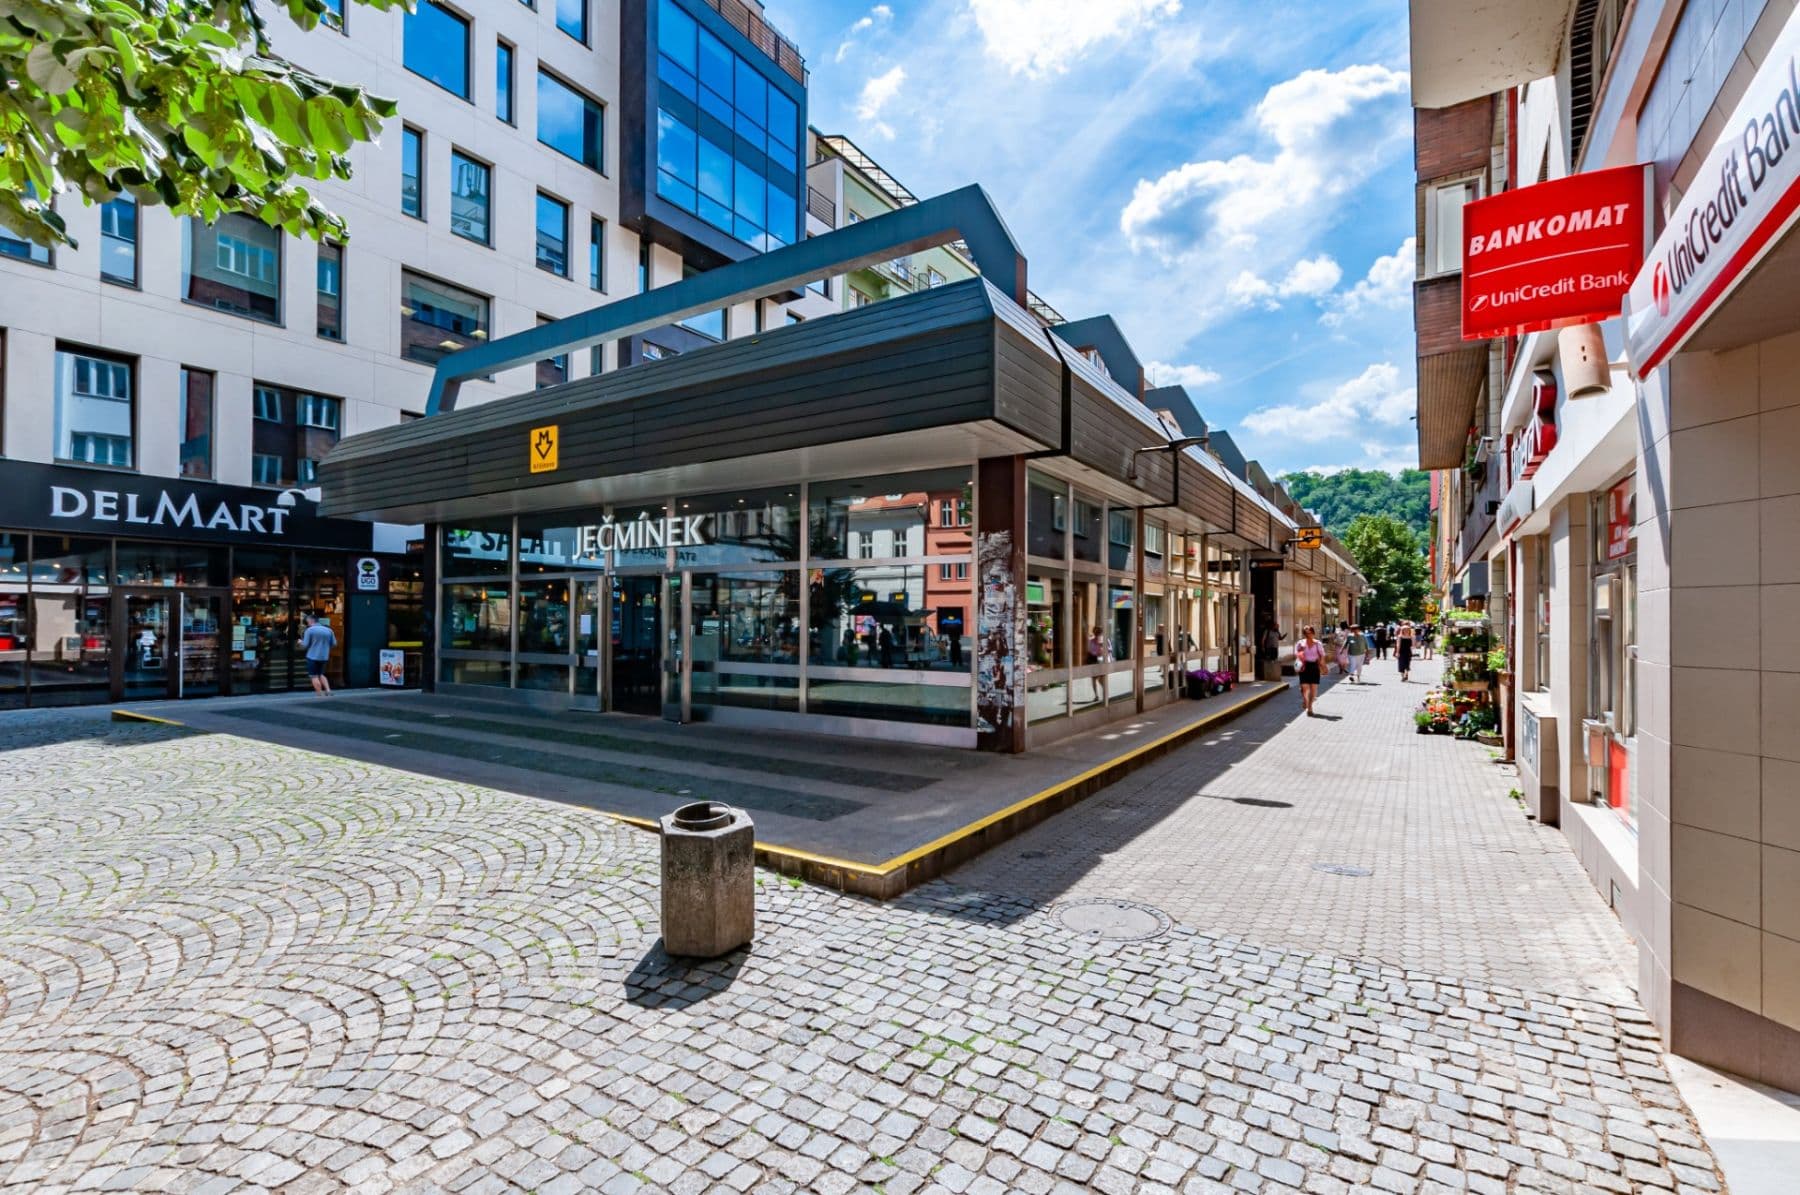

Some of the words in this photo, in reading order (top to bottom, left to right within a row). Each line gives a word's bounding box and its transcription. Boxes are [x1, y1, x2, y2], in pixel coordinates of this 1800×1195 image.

[1468, 203, 1630, 257] BANKOMAT
[1667, 148, 1747, 295] UniCredit
[1489, 279, 1576, 307] UniCredit
[1580, 270, 1630, 291] Bank
[50, 485, 290, 535] DELMART
[573, 511, 707, 561] JEČMÍNEK
